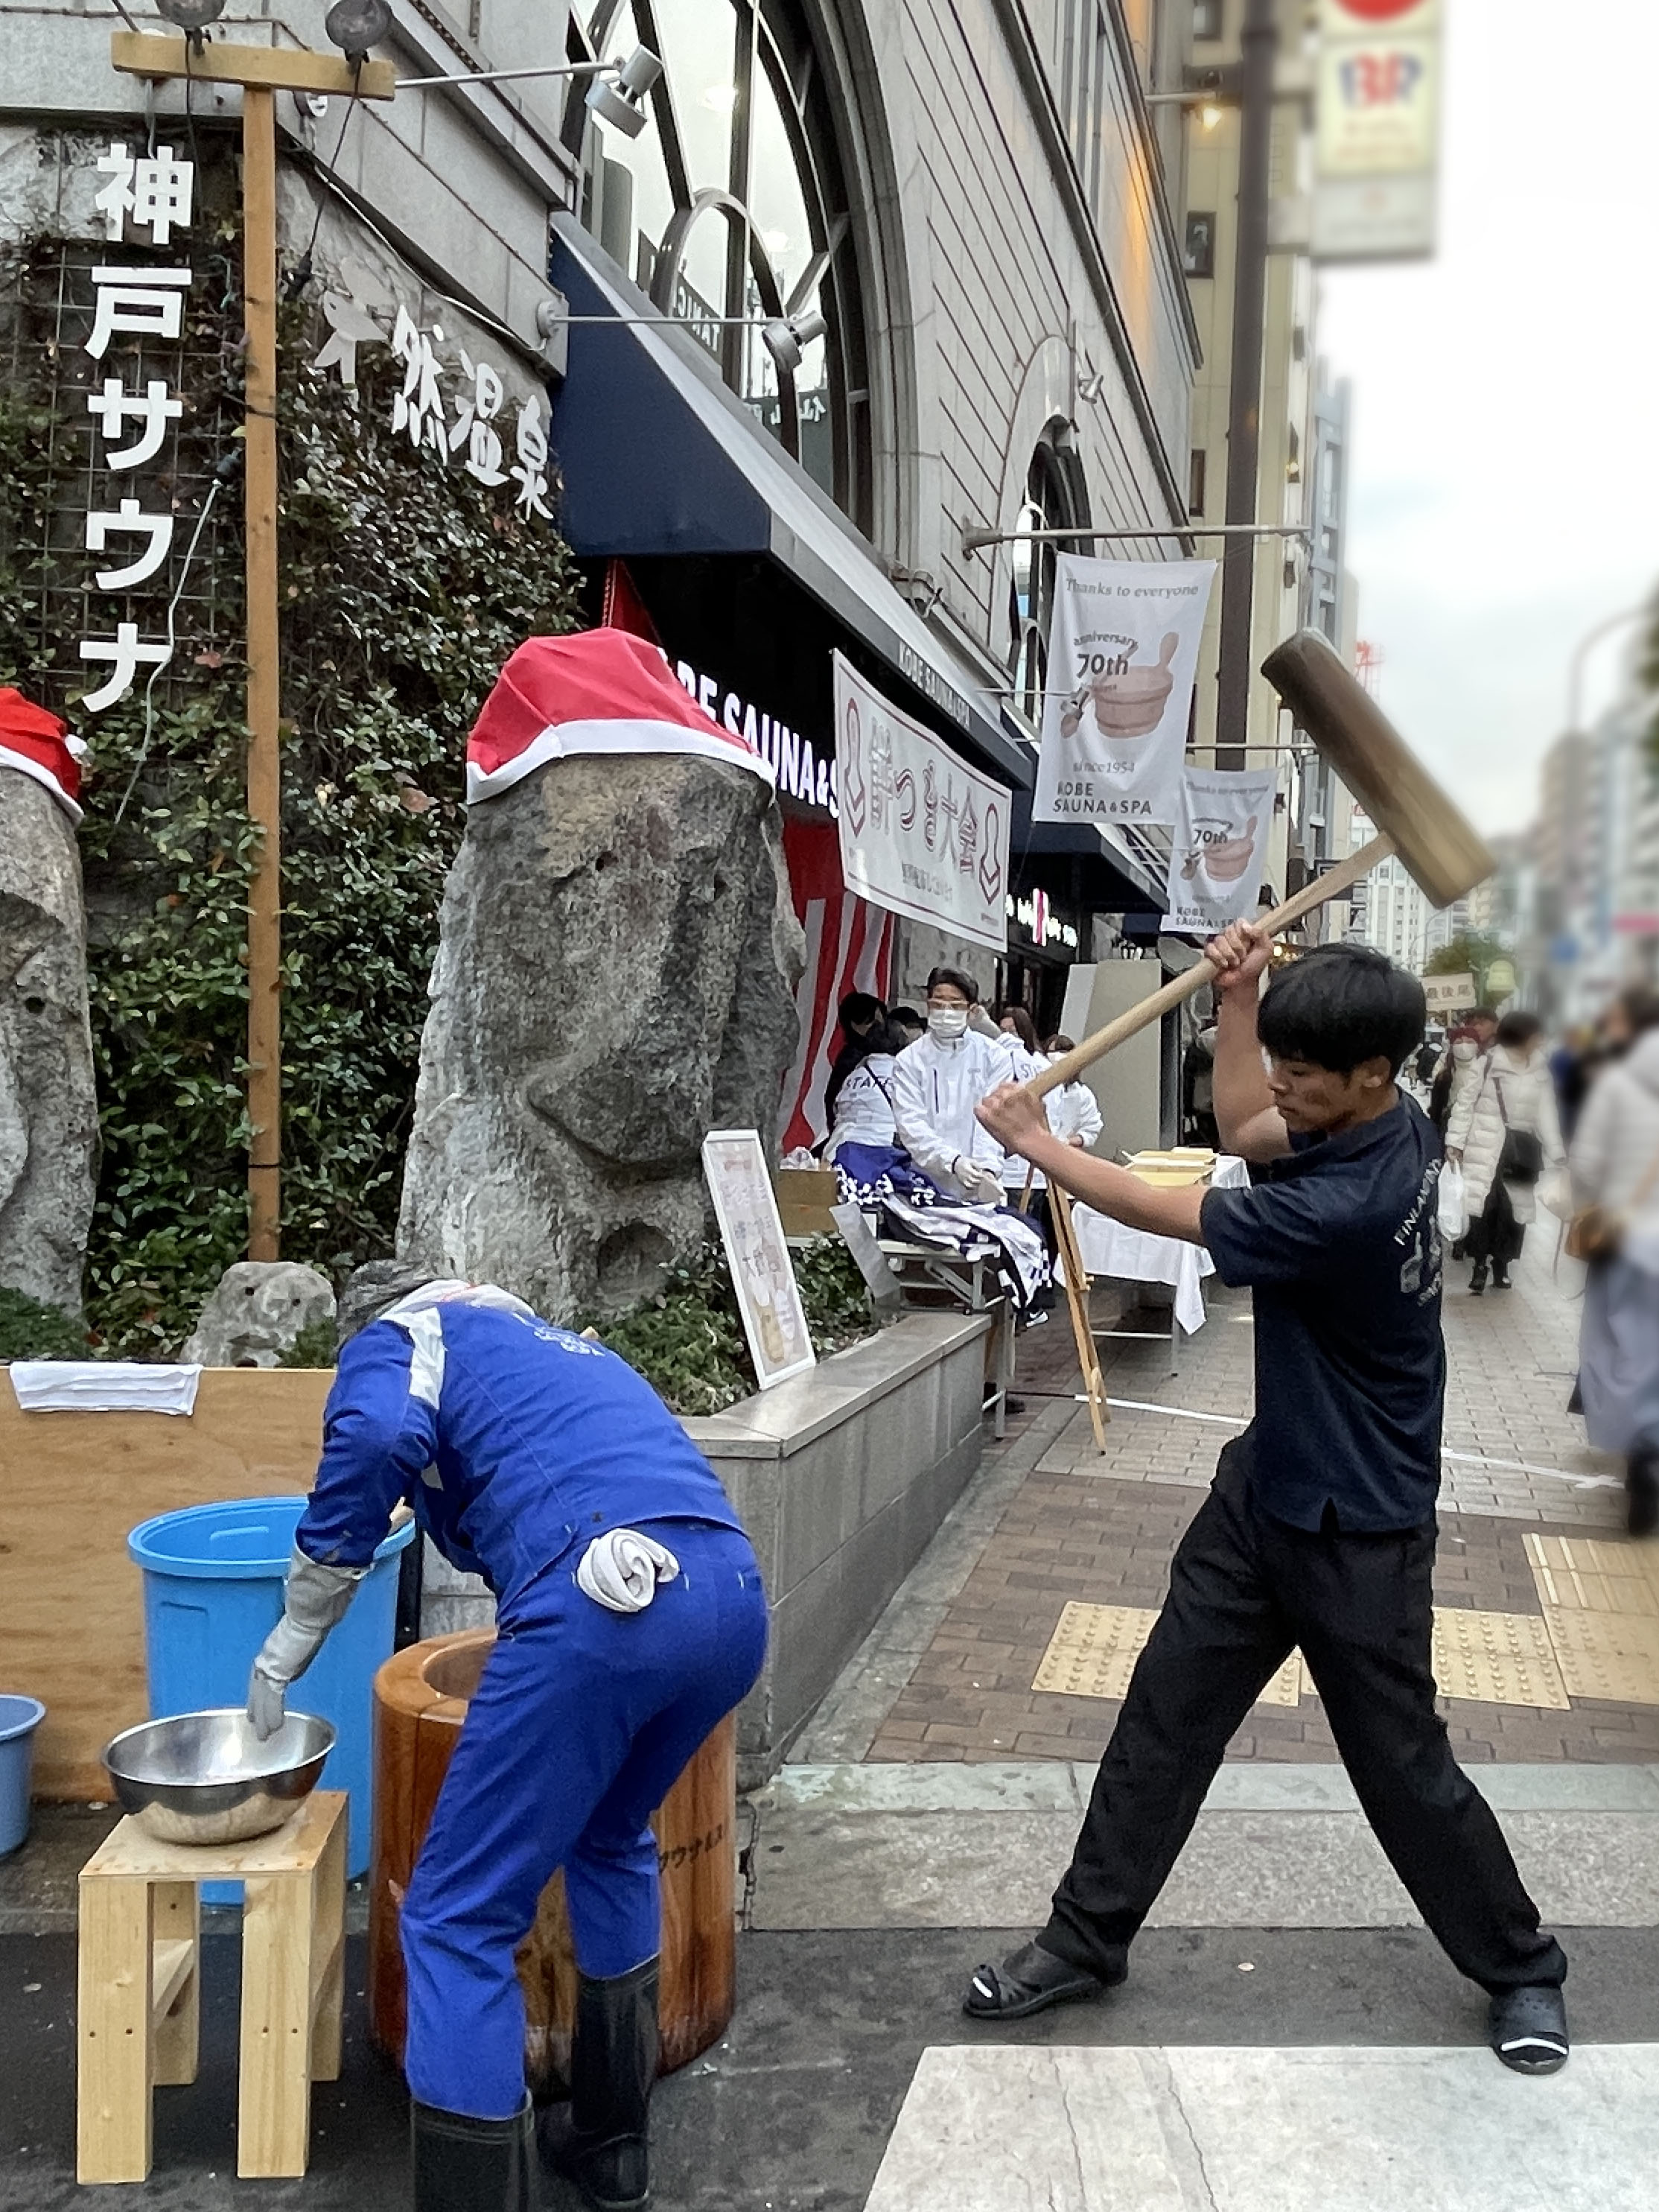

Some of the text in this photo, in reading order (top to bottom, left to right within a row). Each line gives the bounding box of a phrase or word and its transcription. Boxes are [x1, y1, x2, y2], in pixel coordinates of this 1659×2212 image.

[315, 258, 555, 521] 天然温泉
[78, 143, 194, 712] 神戸サウナ
[1066, 577, 1199, 599] Thanks to everyone
[1074, 631, 1139, 648] anniversary
[1077, 652, 1129, 678] 70th
[1057, 780, 1093, 796] KOBE
[1194, 829, 1227, 845] 70th
